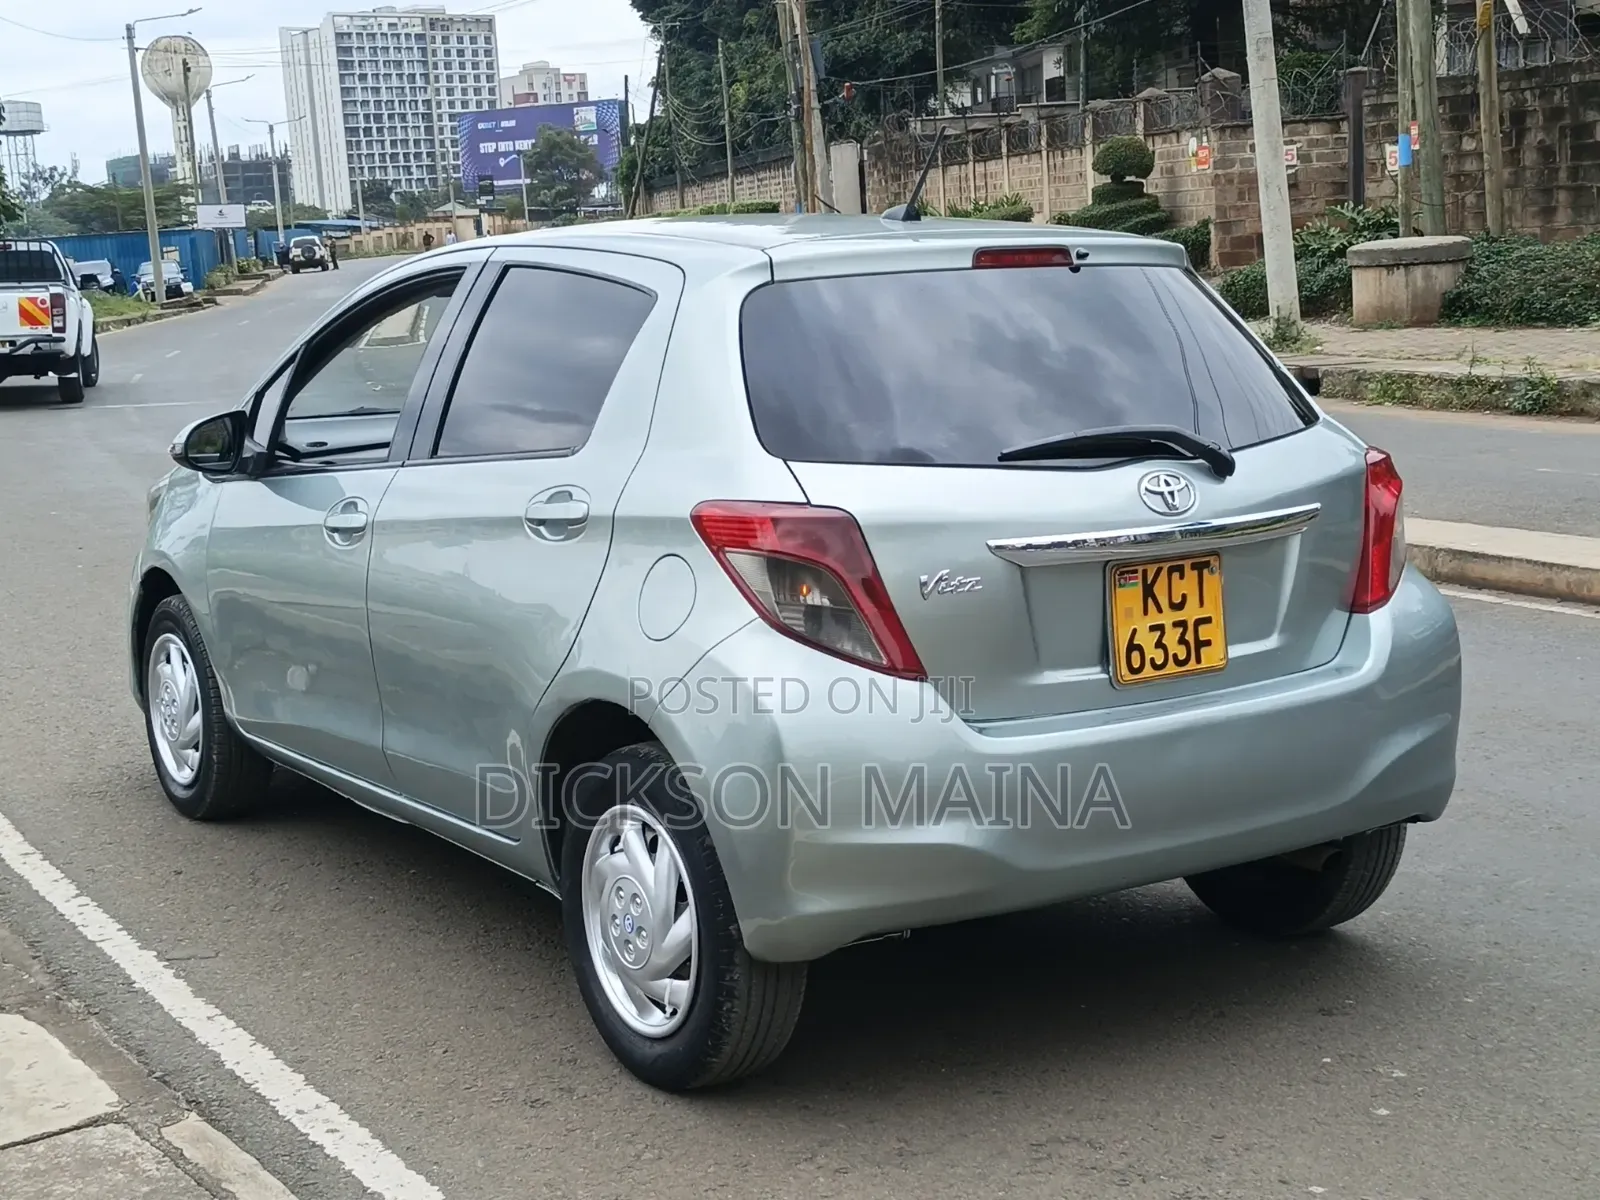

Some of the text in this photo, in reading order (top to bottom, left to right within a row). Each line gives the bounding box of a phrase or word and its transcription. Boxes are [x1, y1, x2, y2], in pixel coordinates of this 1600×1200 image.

[479, 142, 497, 154] STEP
[497, 140, 514, 152] INTO
[1284, 148, 1295, 162] 5
[1388, 151, 1398, 167] 5
[1141, 560, 1211, 616] KCT
[1125, 616, 1213, 675] 633F
